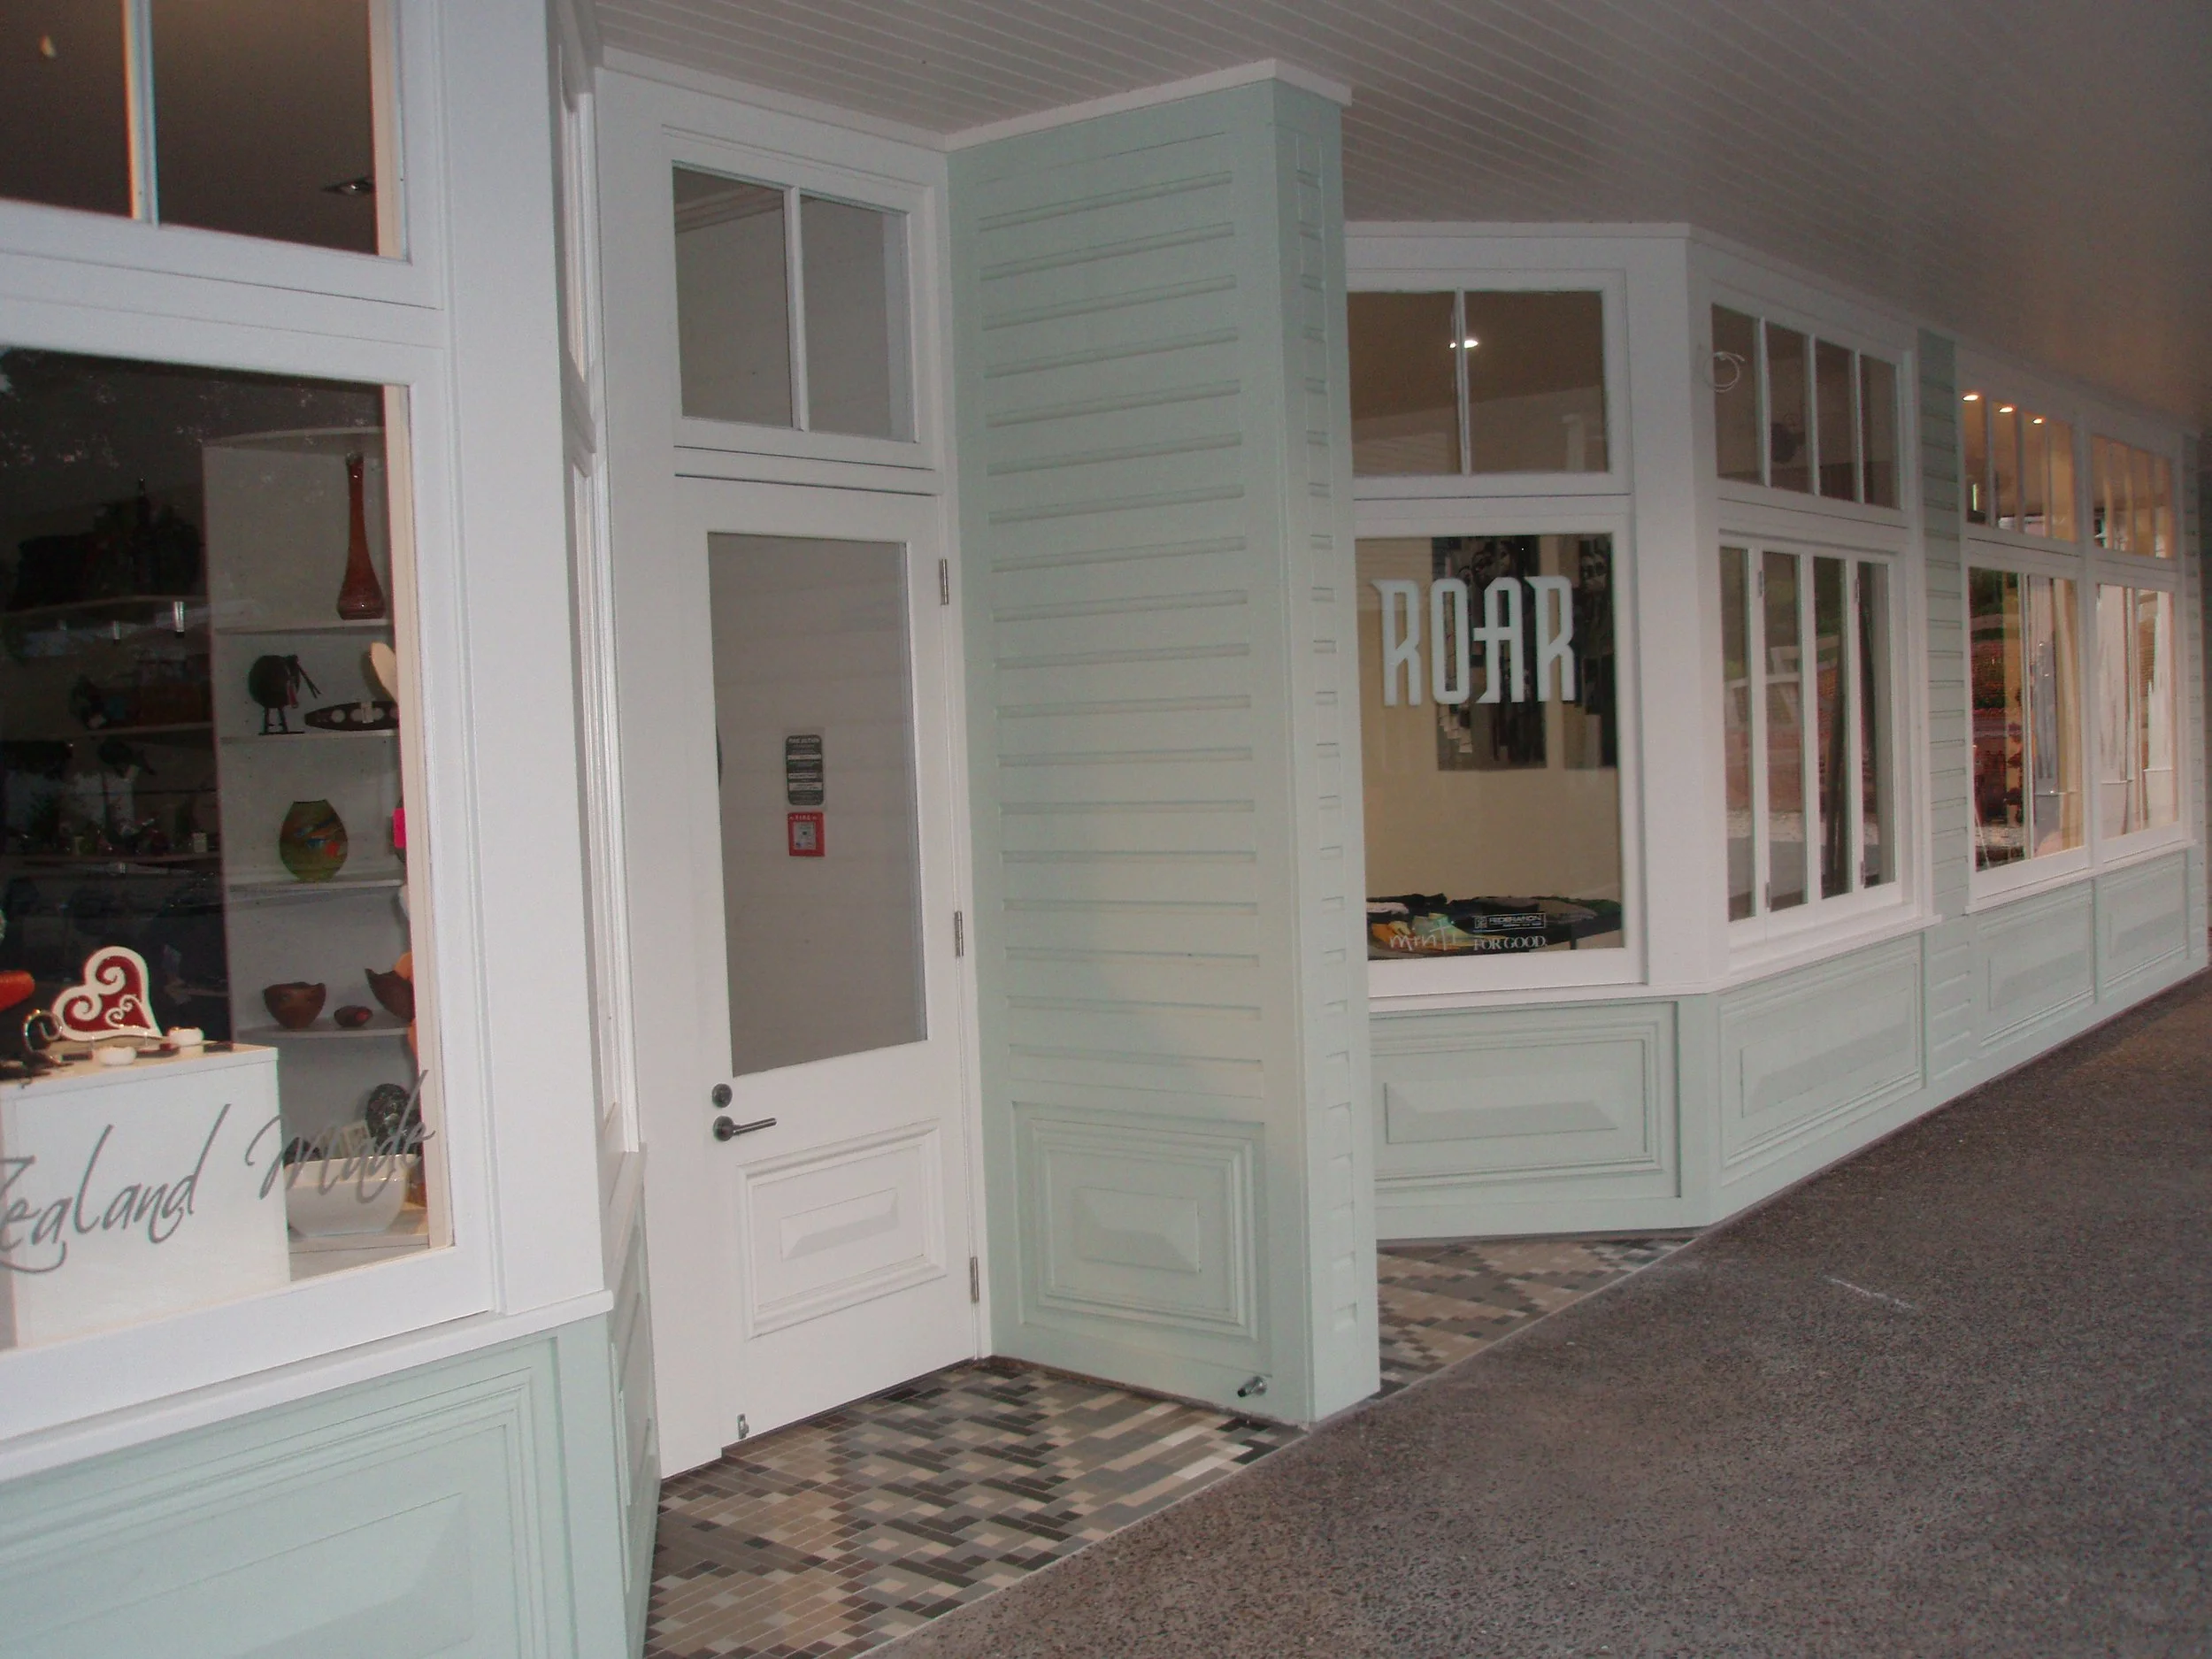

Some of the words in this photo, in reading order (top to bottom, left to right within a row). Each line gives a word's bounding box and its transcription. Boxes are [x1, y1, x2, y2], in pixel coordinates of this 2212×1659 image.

[1371, 576, 1576, 707] ROAR
[1473, 938, 1502, 951] FOR
[245, 1069, 436, 1204] Made
